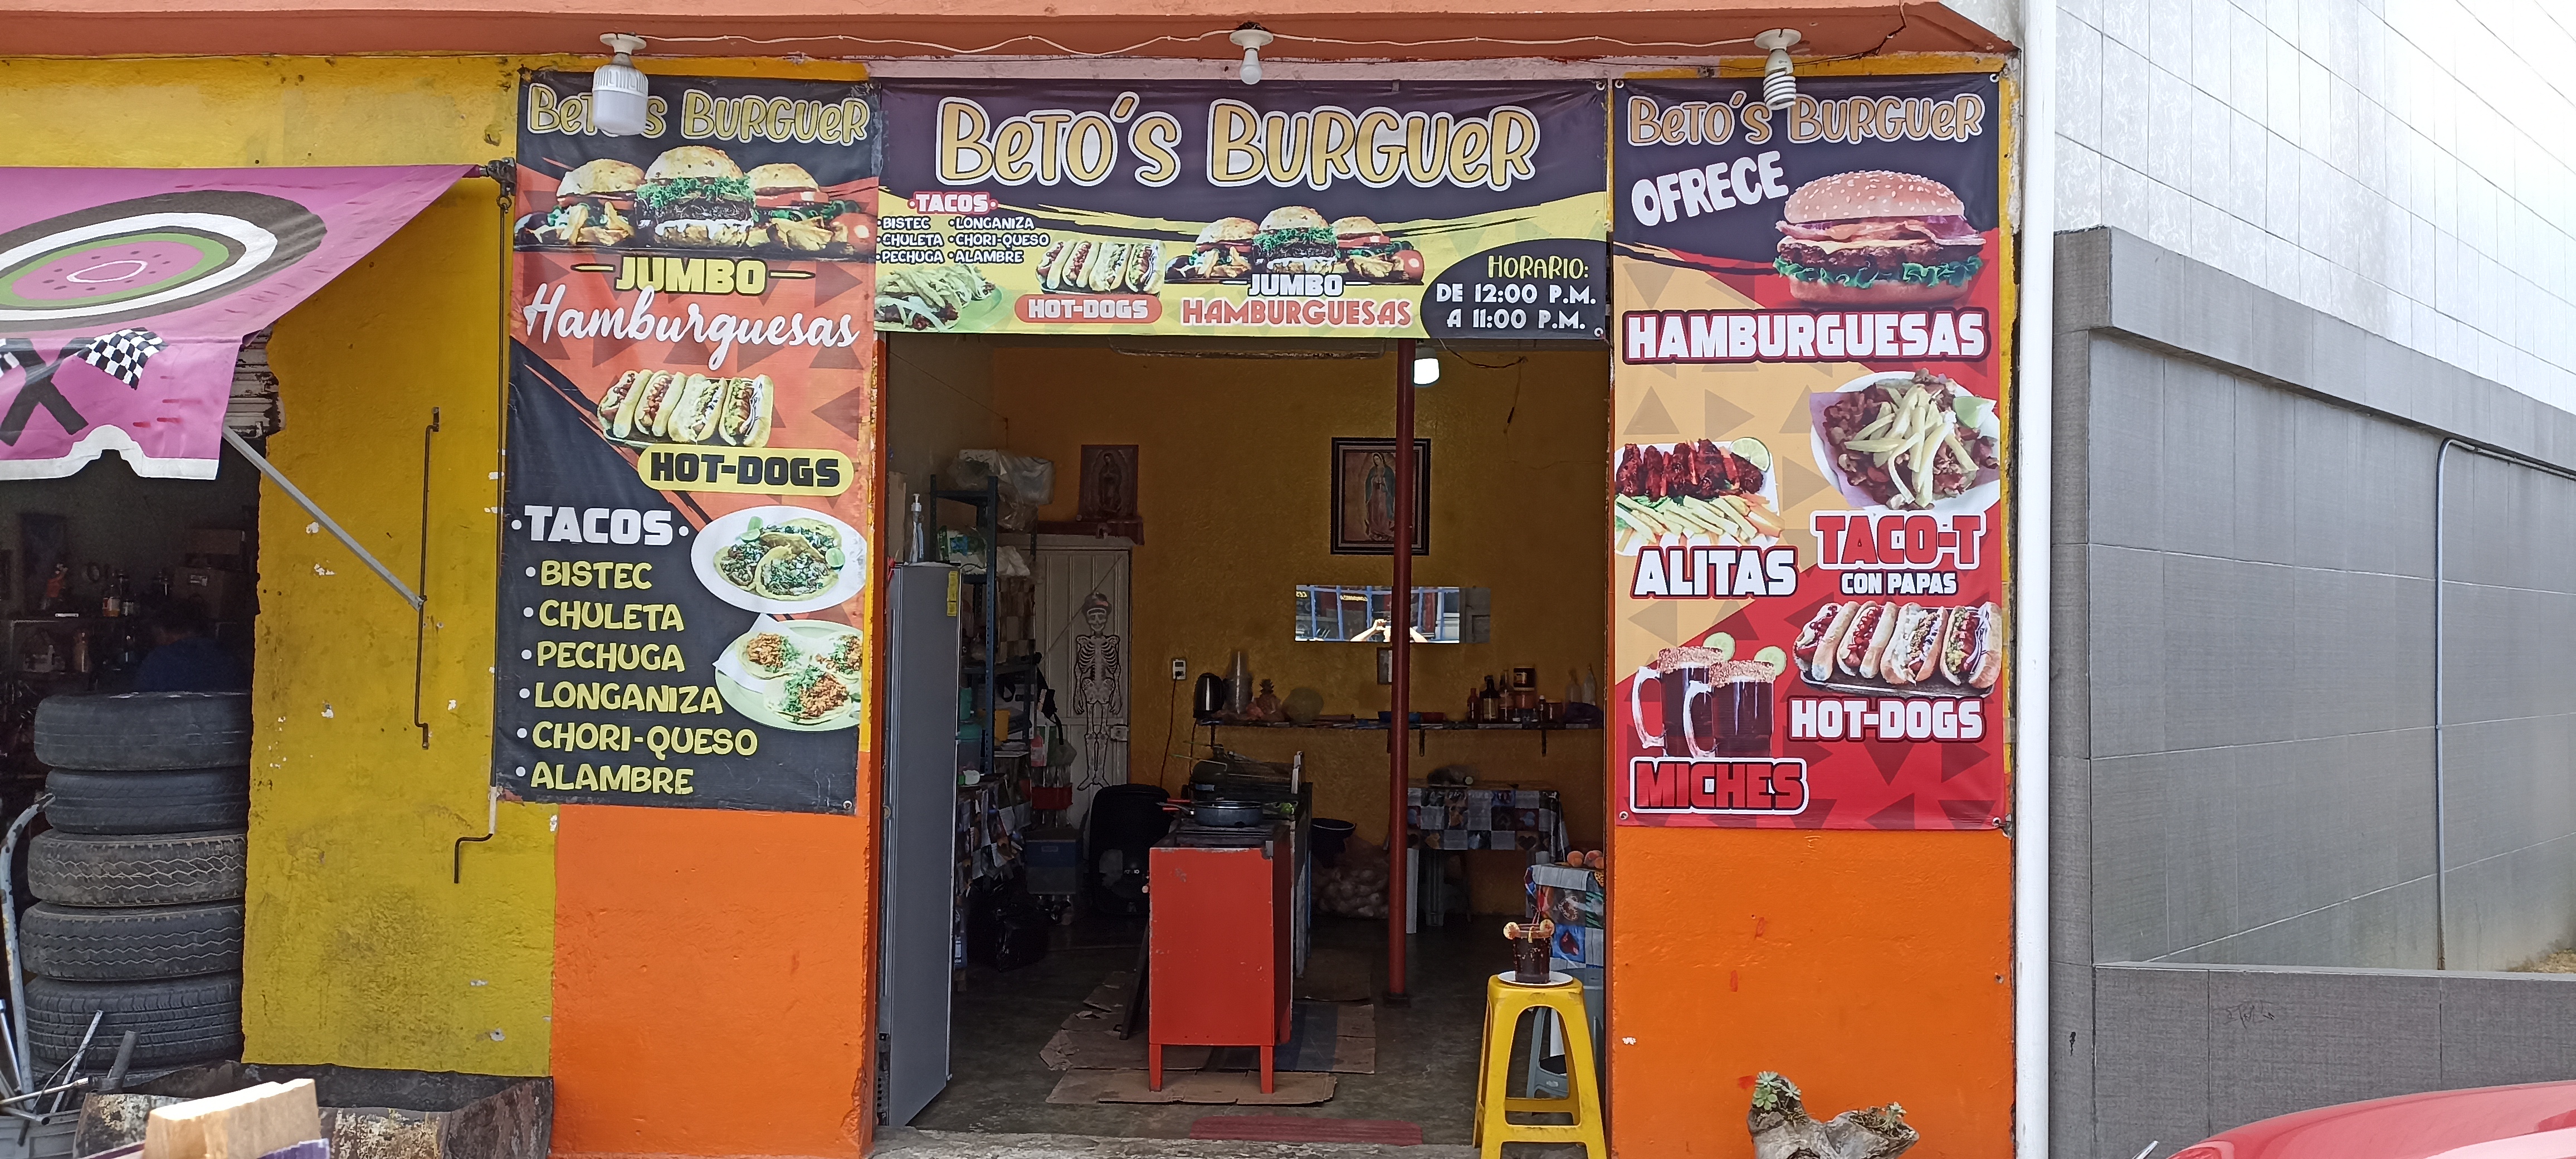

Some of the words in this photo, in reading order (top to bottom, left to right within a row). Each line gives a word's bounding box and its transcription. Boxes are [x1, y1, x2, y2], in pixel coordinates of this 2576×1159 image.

[915, 194, 989, 213] TACOS
[1631, 150, 1789, 227] OFRECE
[882, 216, 931, 230] BISTEC
[955, 216, 1035, 230] LONGANIZA
[881, 233, 944, 247] CHULETA
[954, 233, 1050, 248] CHORI-QUESO
[881, 250, 944, 264] PECHUGA
[954, 250, 1025, 264] ALAMBRE
[1487, 255, 1590, 279] HORARIO:
[613, 257, 767, 295] JUMBO
[1248, 274, 1343, 297] JUMBO
[1436, 284, 1463, 303] DE
[1475, 283, 1538, 304] 12:00
[1549, 284, 1597, 305] P.M.
[1028, 300, 1149, 319] HOT-DOGS
[1182, 298, 1412, 327] HAMBURGUESAS
[1447, 309, 1461, 328] A
[1472, 309, 1526, 329] 11:00
[1538, 310, 1586, 330] P.M.
[524, 283, 860, 370] Hamburguesas
[1627, 313, 1985, 359] HAMBURGUESAS
[650, 452, 840, 488] HOT-DOGS
[524, 505, 673, 546] TACOS
[1815, 515, 1981, 565] TACO-T
[540, 561, 652, 590] BISTEC
[1635, 549, 1797, 596] ALITAS
[1841, 572, 1882, 595] CON
[1887, 572, 1957, 595] PAPAS
[539, 599, 685, 632] CHULETA
[536, 641, 685, 672] PECHUGA
[534, 681, 723, 715] LONGANIZA
[1791, 699, 1983, 740] HOT-DOGS
[532, 721, 758, 761] CHORI-QUESO
[530, 761, 694, 795] ALAMBRE
[1635, 761, 1806, 811] MICHES
